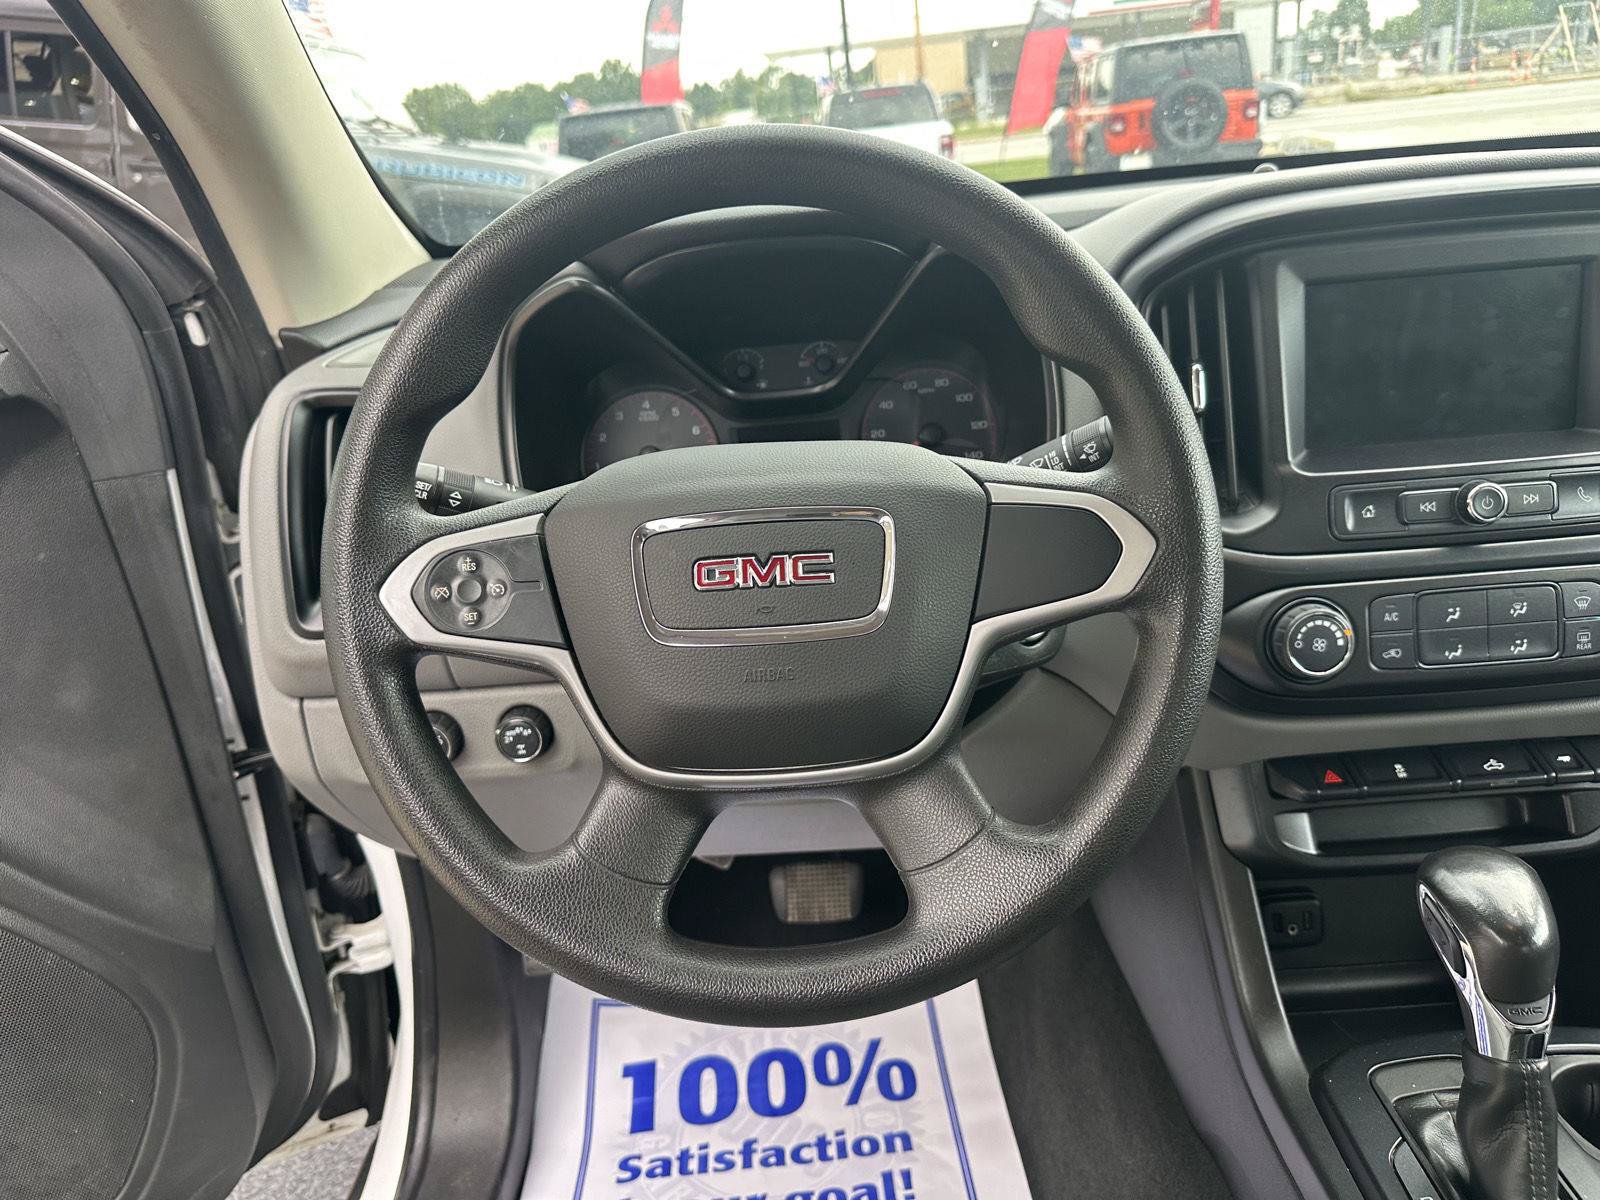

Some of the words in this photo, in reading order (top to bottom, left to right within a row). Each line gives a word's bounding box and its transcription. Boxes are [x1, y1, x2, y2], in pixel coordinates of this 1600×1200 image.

[955, 393, 974, 403] 100
[641, 400, 651, 410] 4
[878, 400, 894, 410] 40
[870, 428, 887, 439] 20
[1050, 457, 1060, 466] LO
[1087, 452, 1101, 464] INT
[461, 562, 477, 573] RES
[693, 551, 837, 592] GMC
[464, 612, 478, 622] SET
[1383, 612, 1399, 622] A/C
[1576, 642, 1592, 650] REAR
[1507, 1006, 1544, 1016] GMC
[621, 1037, 918, 1135] 100%
[615, 1129, 914, 1184] Satisfaction
